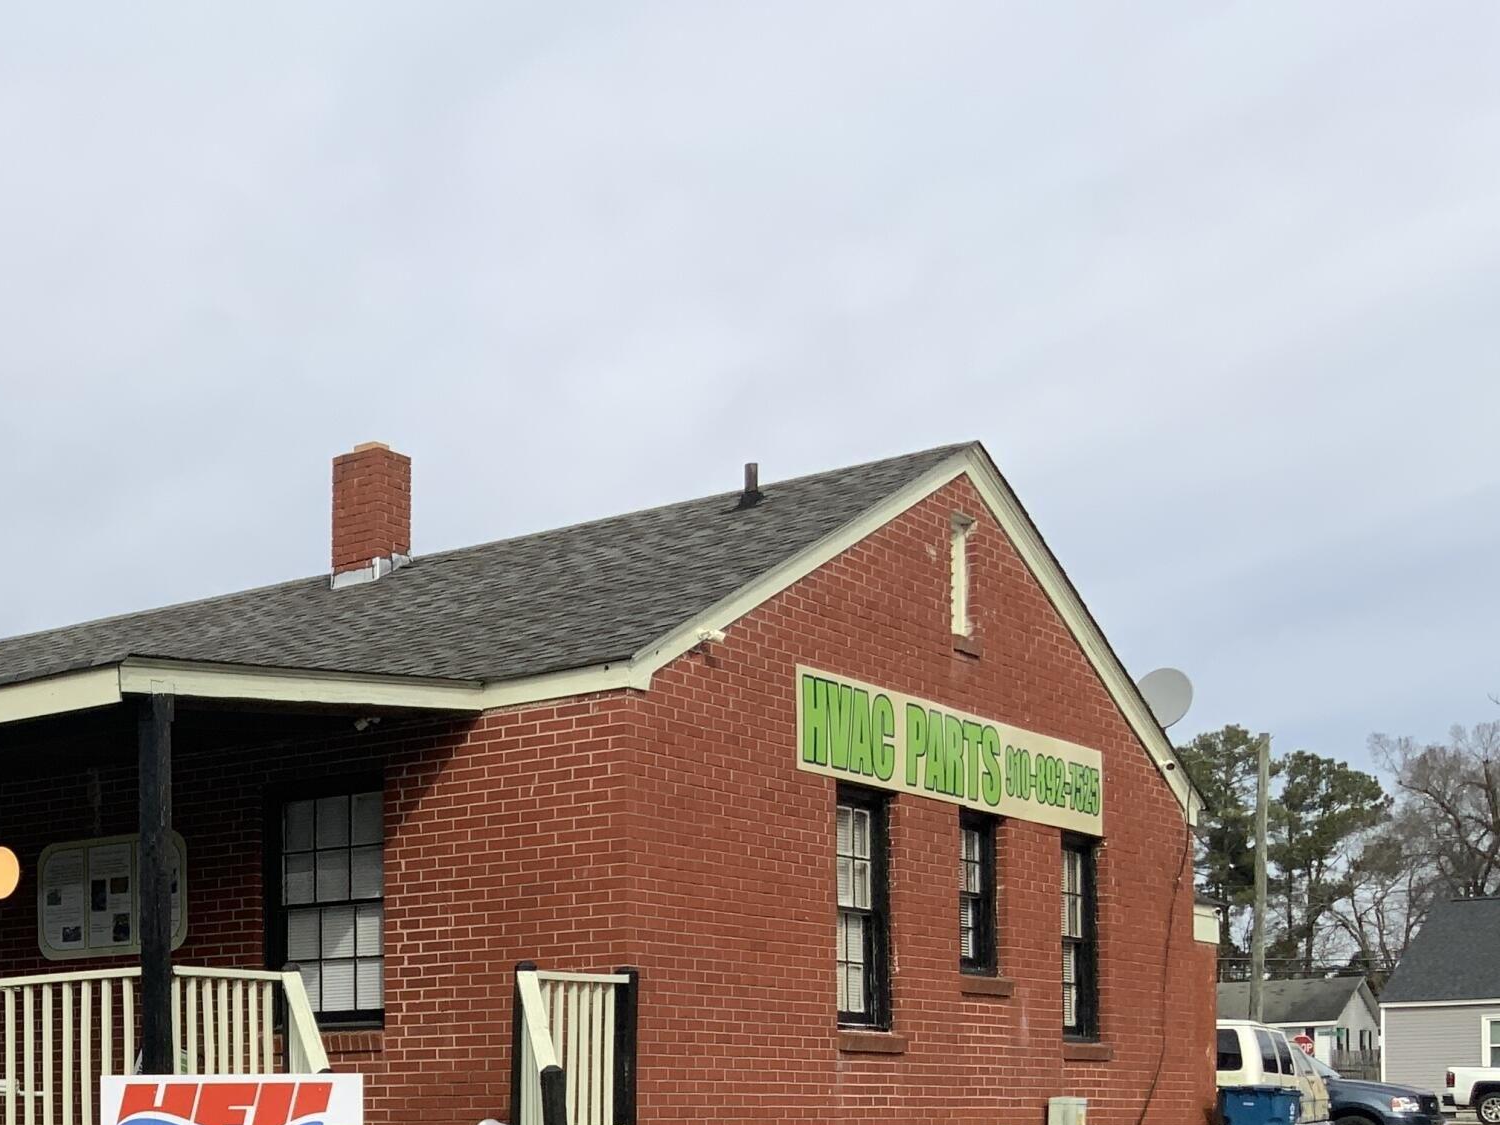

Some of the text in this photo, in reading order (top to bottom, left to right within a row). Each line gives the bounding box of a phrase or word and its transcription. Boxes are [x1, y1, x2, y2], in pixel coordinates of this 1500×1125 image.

[802, 674, 1100, 816] HVAC PARTS 910-892-7525
